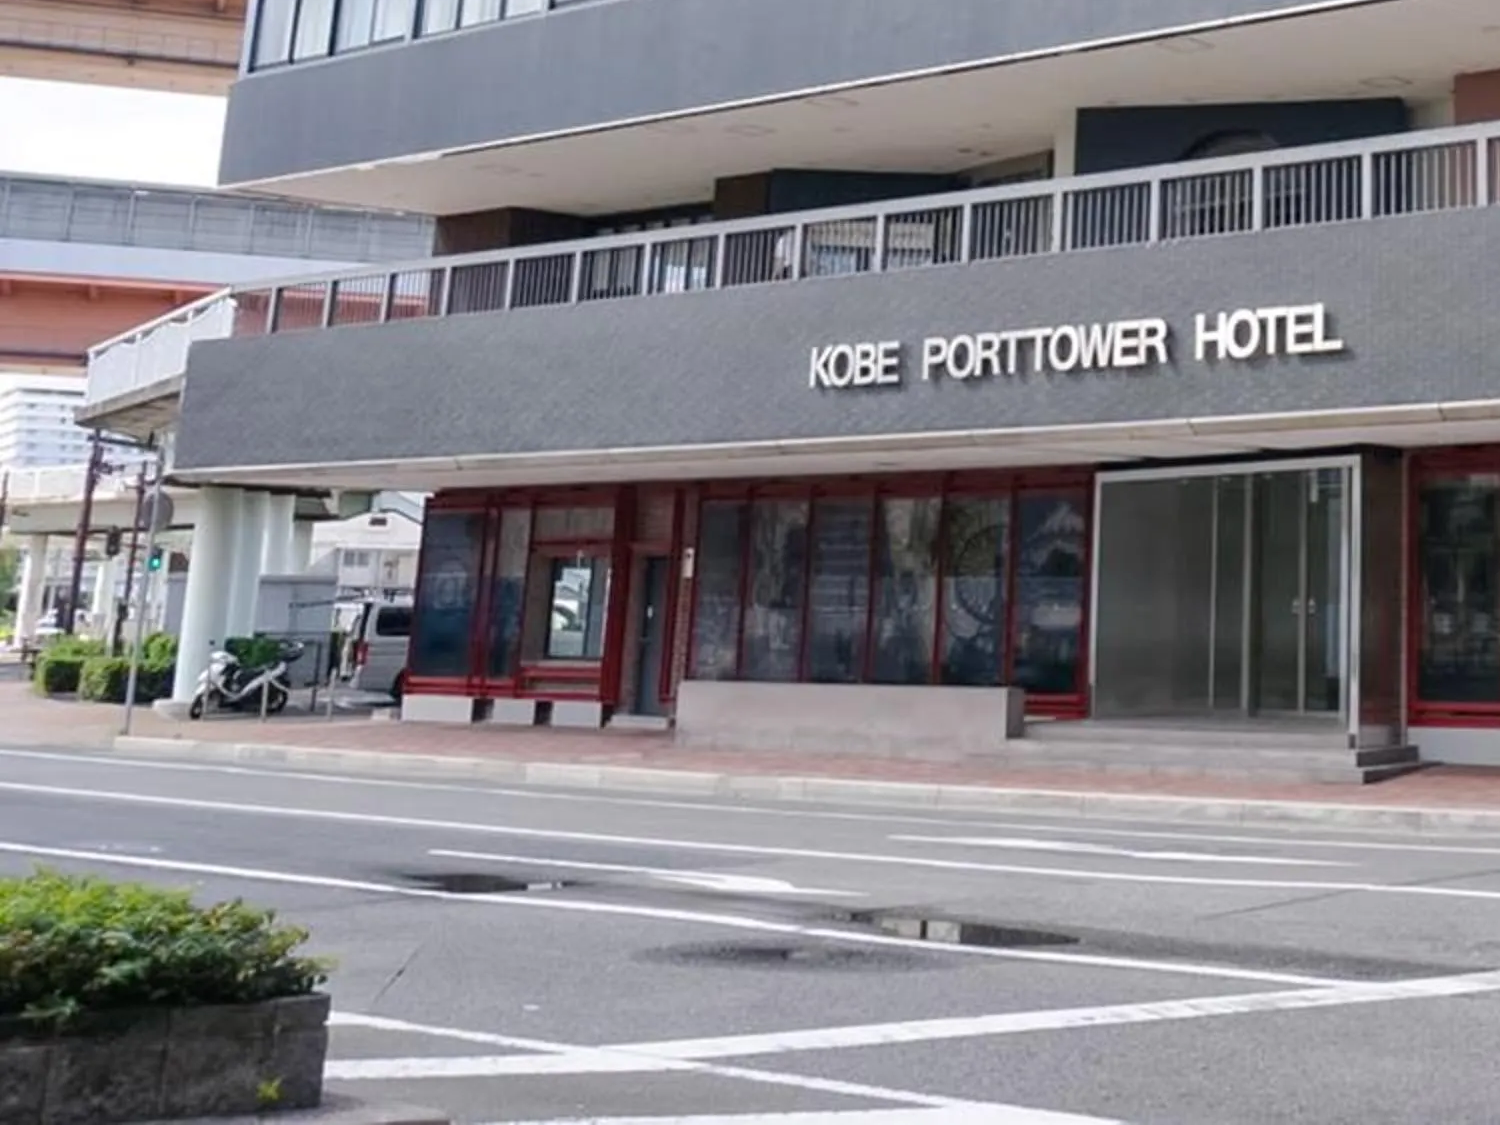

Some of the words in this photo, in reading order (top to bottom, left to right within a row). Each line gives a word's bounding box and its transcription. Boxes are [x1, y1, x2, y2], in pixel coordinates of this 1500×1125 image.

[809, 340, 900, 388] KOBE
[922, 318, 1168, 380] PORTTOWER
[1195, 302, 1343, 361] HOTEL
